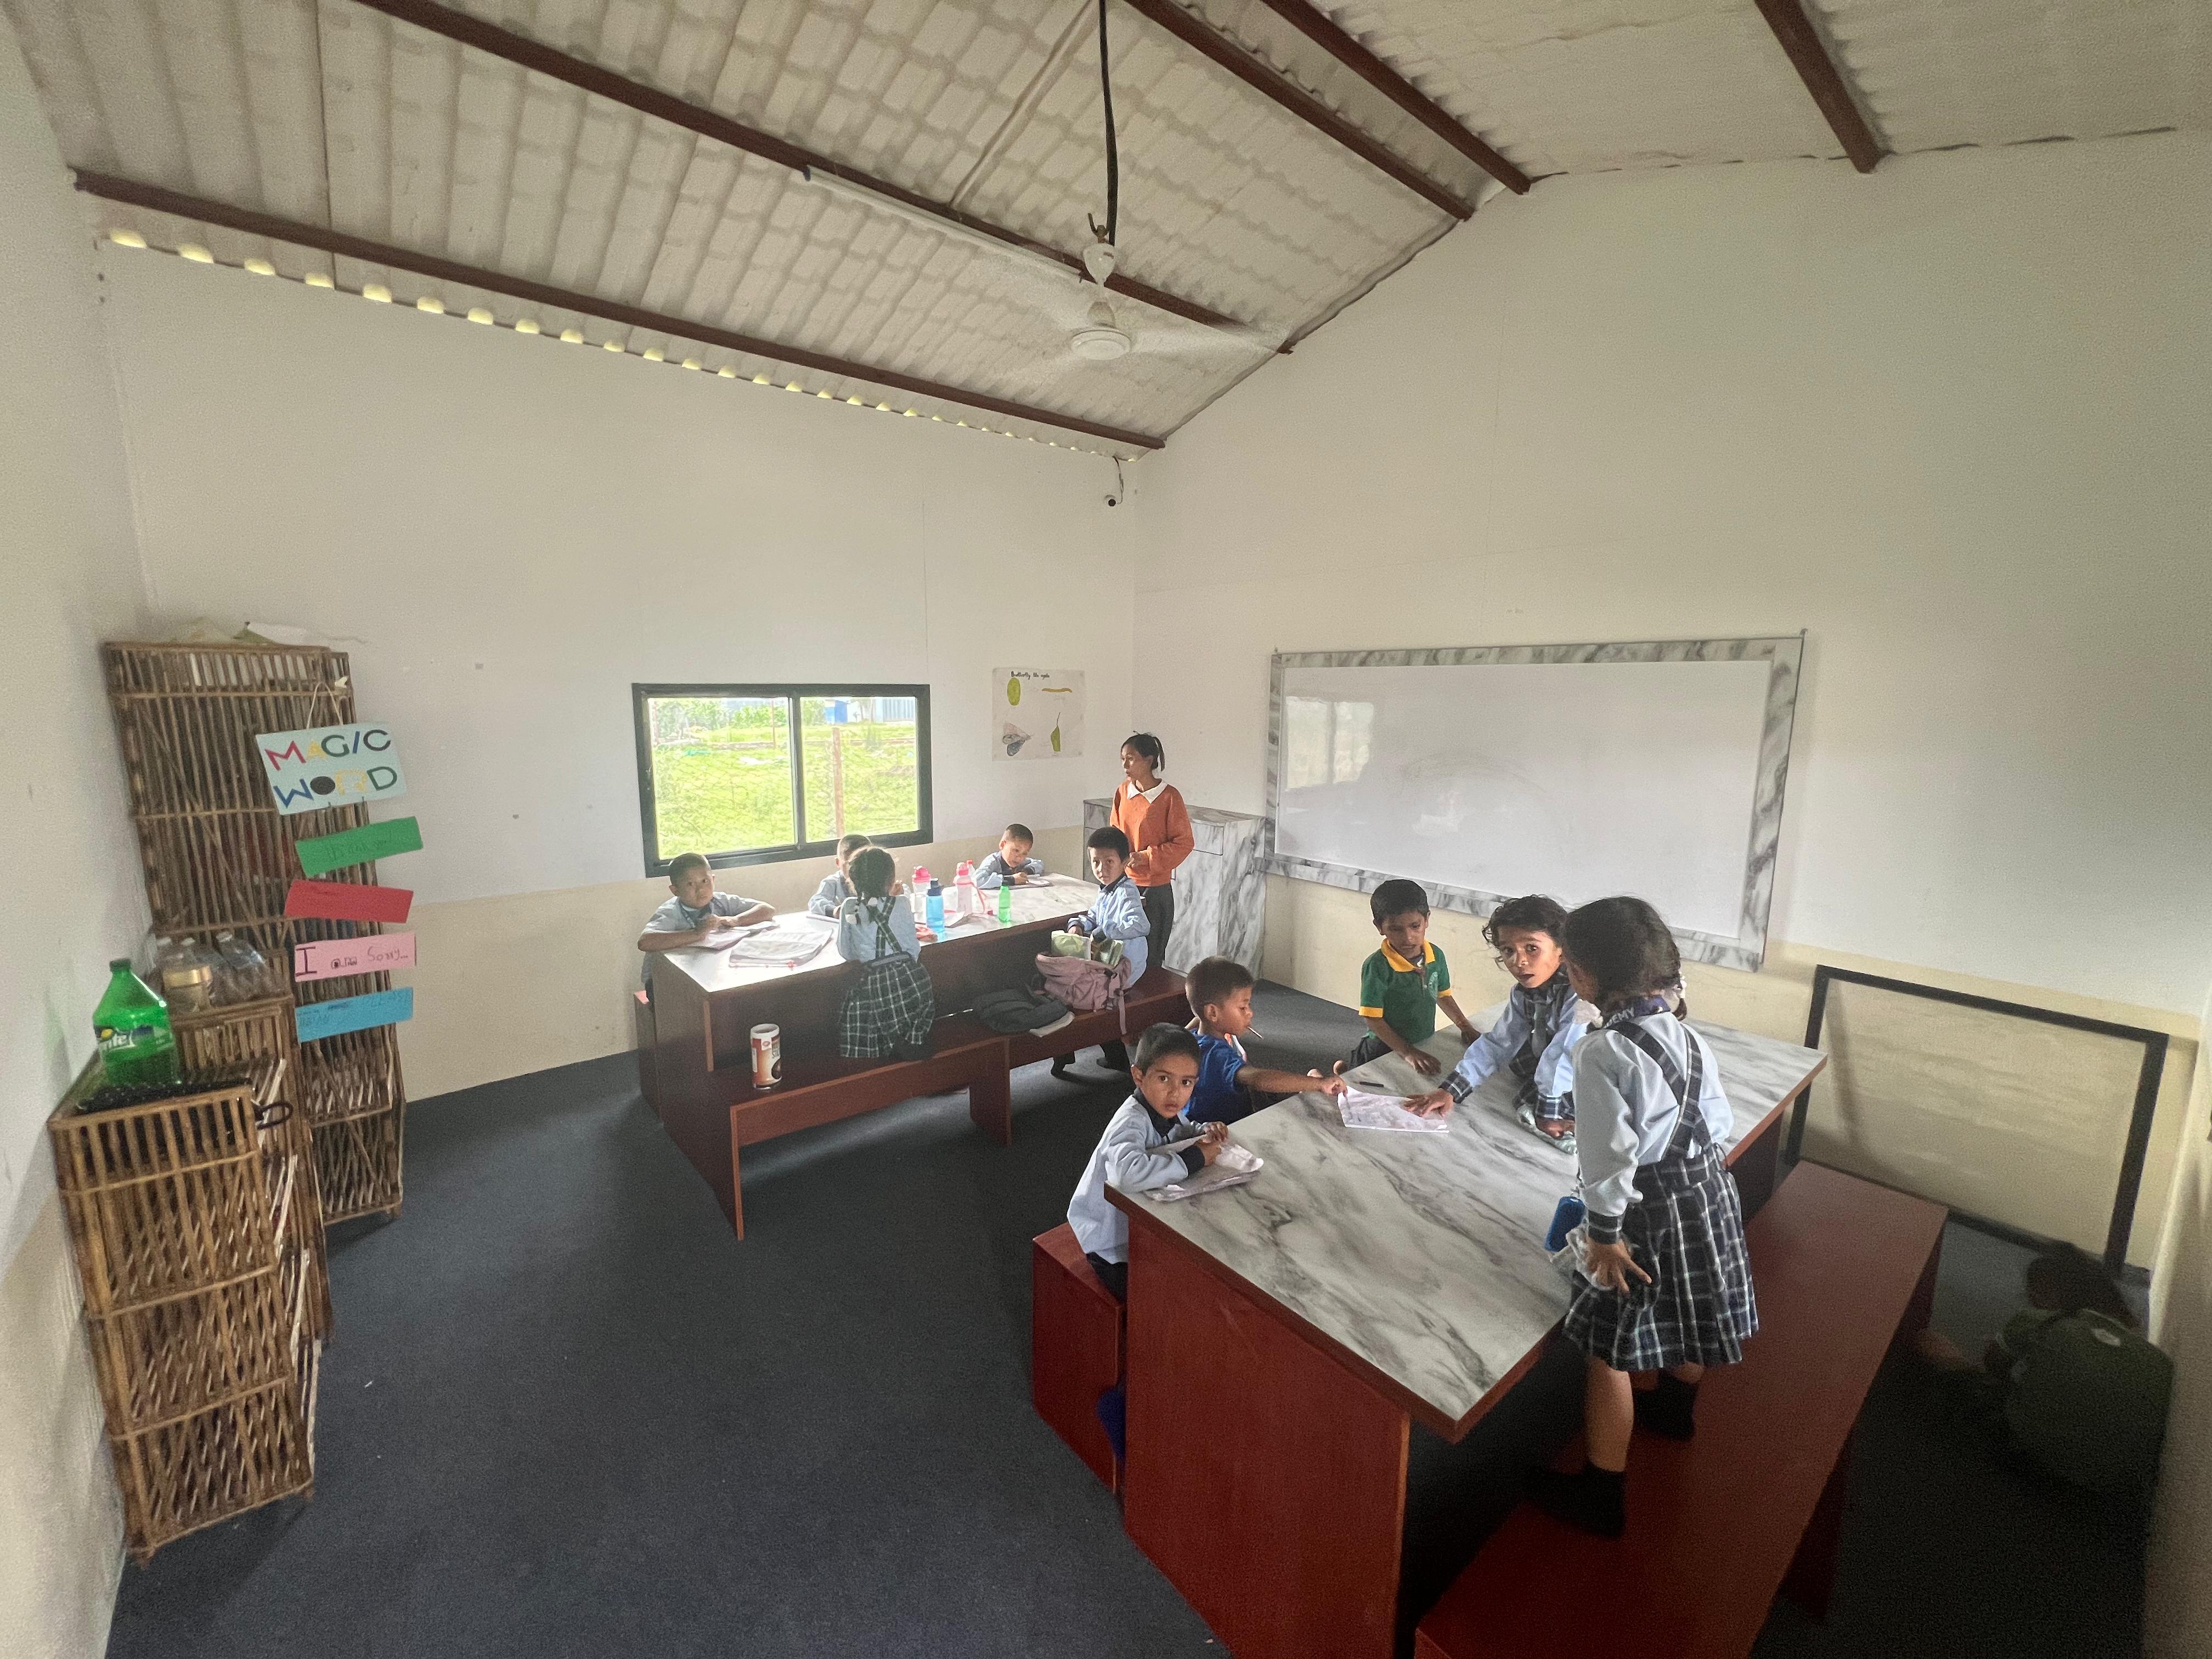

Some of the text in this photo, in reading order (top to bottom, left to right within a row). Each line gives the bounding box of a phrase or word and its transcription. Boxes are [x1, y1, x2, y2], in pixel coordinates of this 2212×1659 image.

[264, 729, 391, 771] MAGIC
[273, 766, 397, 809] WORD
[295, 946, 317, 977] I
[1604, 1007, 1635, 1028] DEMY
